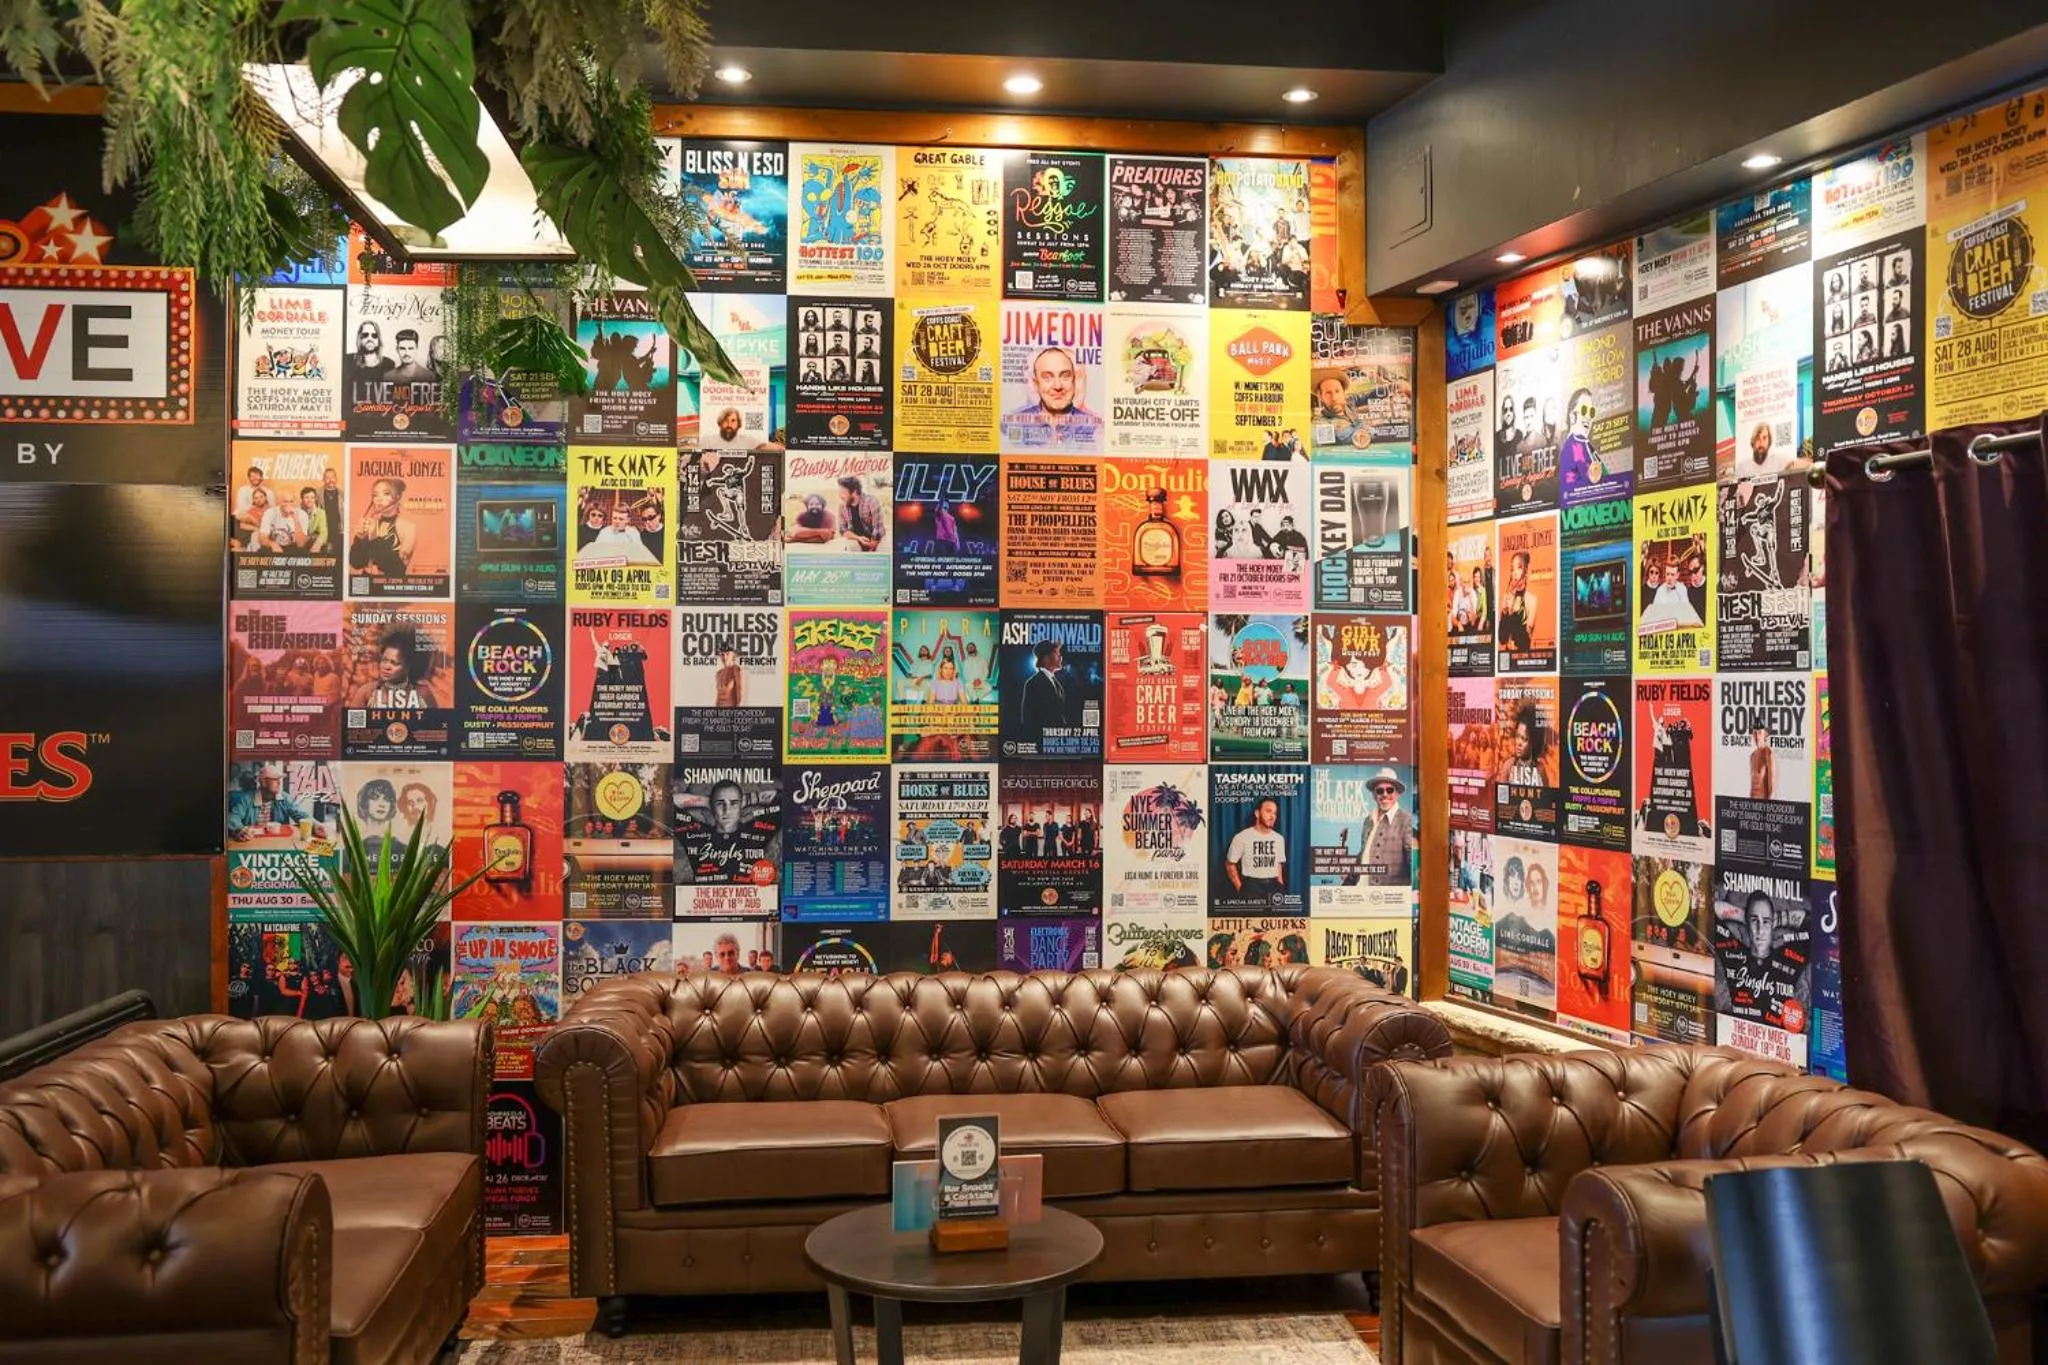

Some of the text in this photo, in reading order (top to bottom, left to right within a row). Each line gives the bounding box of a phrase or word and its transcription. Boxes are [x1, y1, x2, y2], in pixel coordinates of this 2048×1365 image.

[686, 150, 784, 175] BLISS N ESO
[914, 153, 985, 165] GREAT GABLE
[1112, 166, 1203, 185] PREATURES
[799, 246, 884, 260] HOTTEST 100
[1964, 235, 2010, 273] CRAFT
[1967, 261, 2013, 298] BEER
[269, 297, 313, 310] LIME
[257, 311, 327, 324] CORDIALE
[1638, 304, 1712, 342] THE VANNS
[261, 327, 320, 336] MONEY TOUR
[926, 325, 964, 341] CRAFT
[1003, 311, 1102, 347] JIMEOIN
[737, 339, 779, 351] PYKE
[929, 341, 965, 357] BEER
[1231, 341, 1289, 357] BALL PARK
[1934, 327, 1997, 363] SAT 28 AUG
[930, 357, 967, 366] FESTIVAL
[1076, 349, 1101, 365] LIVE
[247, 388, 268, 396] THE
[270, 388, 299, 396] HOEY
[901, 385, 953, 396] SAT 28 AUG
[1234, 393, 1284, 403] COFFS HARBOUR
[247, 396, 332, 404] COFFS HARBOUR
[1114, 397, 1150, 406] NUTBUSH
[246, 404, 297, 412] SATURDAY
[299, 404, 322, 412] MAY
[1113, 407, 1200, 421] DANCE-OFF
[1235, 416, 1283, 426] SEPTEMBER 3
[18, 442, 64, 464] BY
[357, 460, 445, 477] JAGUAR JONZE
[577, 454, 668, 477] THE CHATS
[896, 463, 997, 502] ILLY
[1008, 514, 1097, 527] THE PROPELLERS
[1320, 471, 1349, 602] HOCKEY DAD
[1236, 564, 1283, 573] THE HOEY MOEY
[575, 570, 652, 583] FRIDAY 09 APRIL
[351, 614, 447, 624] SUNDAY SESSIONS
[573, 613, 668, 628] RUBY FIELDS
[682, 613, 778, 633] RUTHLESS
[900, 618, 991, 635] PIRRA
[609, 633, 633, 641] LOSER
[1341, 626, 1380, 638] GIRL
[682, 633, 778, 656] COMEDY
[1342, 638, 1380, 650] PWR
[477, 645, 542, 659] BEACH
[483, 660, 537, 674] ROCK
[683, 657, 777, 666] IS BACK! FRENCHY
[376, 690, 420, 709] LISA
[1136, 685, 1177, 704] CRAFT
[1636, 684, 1709, 701] RUBY FIELDS
[1721, 680, 1806, 706] RUTHLESS
[372, 711, 424, 720] HUNT
[1136, 705, 1176, 724] BEER
[1663, 708, 1682, 717] LOSER
[1573, 721, 1616, 738] BEACH
[1721, 707, 1806, 737] COMEDY
[1577, 739, 1612, 754] ROCK
[1722, 737, 1805, 749] IS BACK! FRENCHY
[684, 768, 774, 784] SHANNON NOLL
[1215, 773, 1304, 784] TASMAN KEITH
[1513, 765, 1540, 786] LISA
[793, 770, 881, 810] Sheppard
[1316, 780, 1365, 802] BLACK
[1131, 795, 1153, 813] NYE
[1123, 814, 1173, 831] SUMMER
[1135, 831, 1173, 849] BEACH
[687, 842, 764, 866] THE Singles TOUR
[1253, 841, 1275, 855] FREE
[1001, 860, 1049, 869] SATURDAY
[1052, 861, 1085, 869] MARCH
[1253, 856, 1275, 869] SHOW
[696, 887, 758, 897] THE HOEY MOEY
[1724, 871, 1803, 901] SHANNON NOLL
[232, 896, 293, 905] THU AUG 30
[693, 900, 724, 909] SUNDAY
[744, 900, 761, 909] AUG
[1212, 919, 1306, 931] LITTLE QUIRKS
[469, 939, 555, 960] UP IN SMOKE
[1325, 928, 1398, 958] BAGGY TROUSERS
[567, 958, 657, 974] the BLACK
[944, 1183, 993, 1193] Bar Snacks
[952, 1192, 993, 1201] Cocktails
